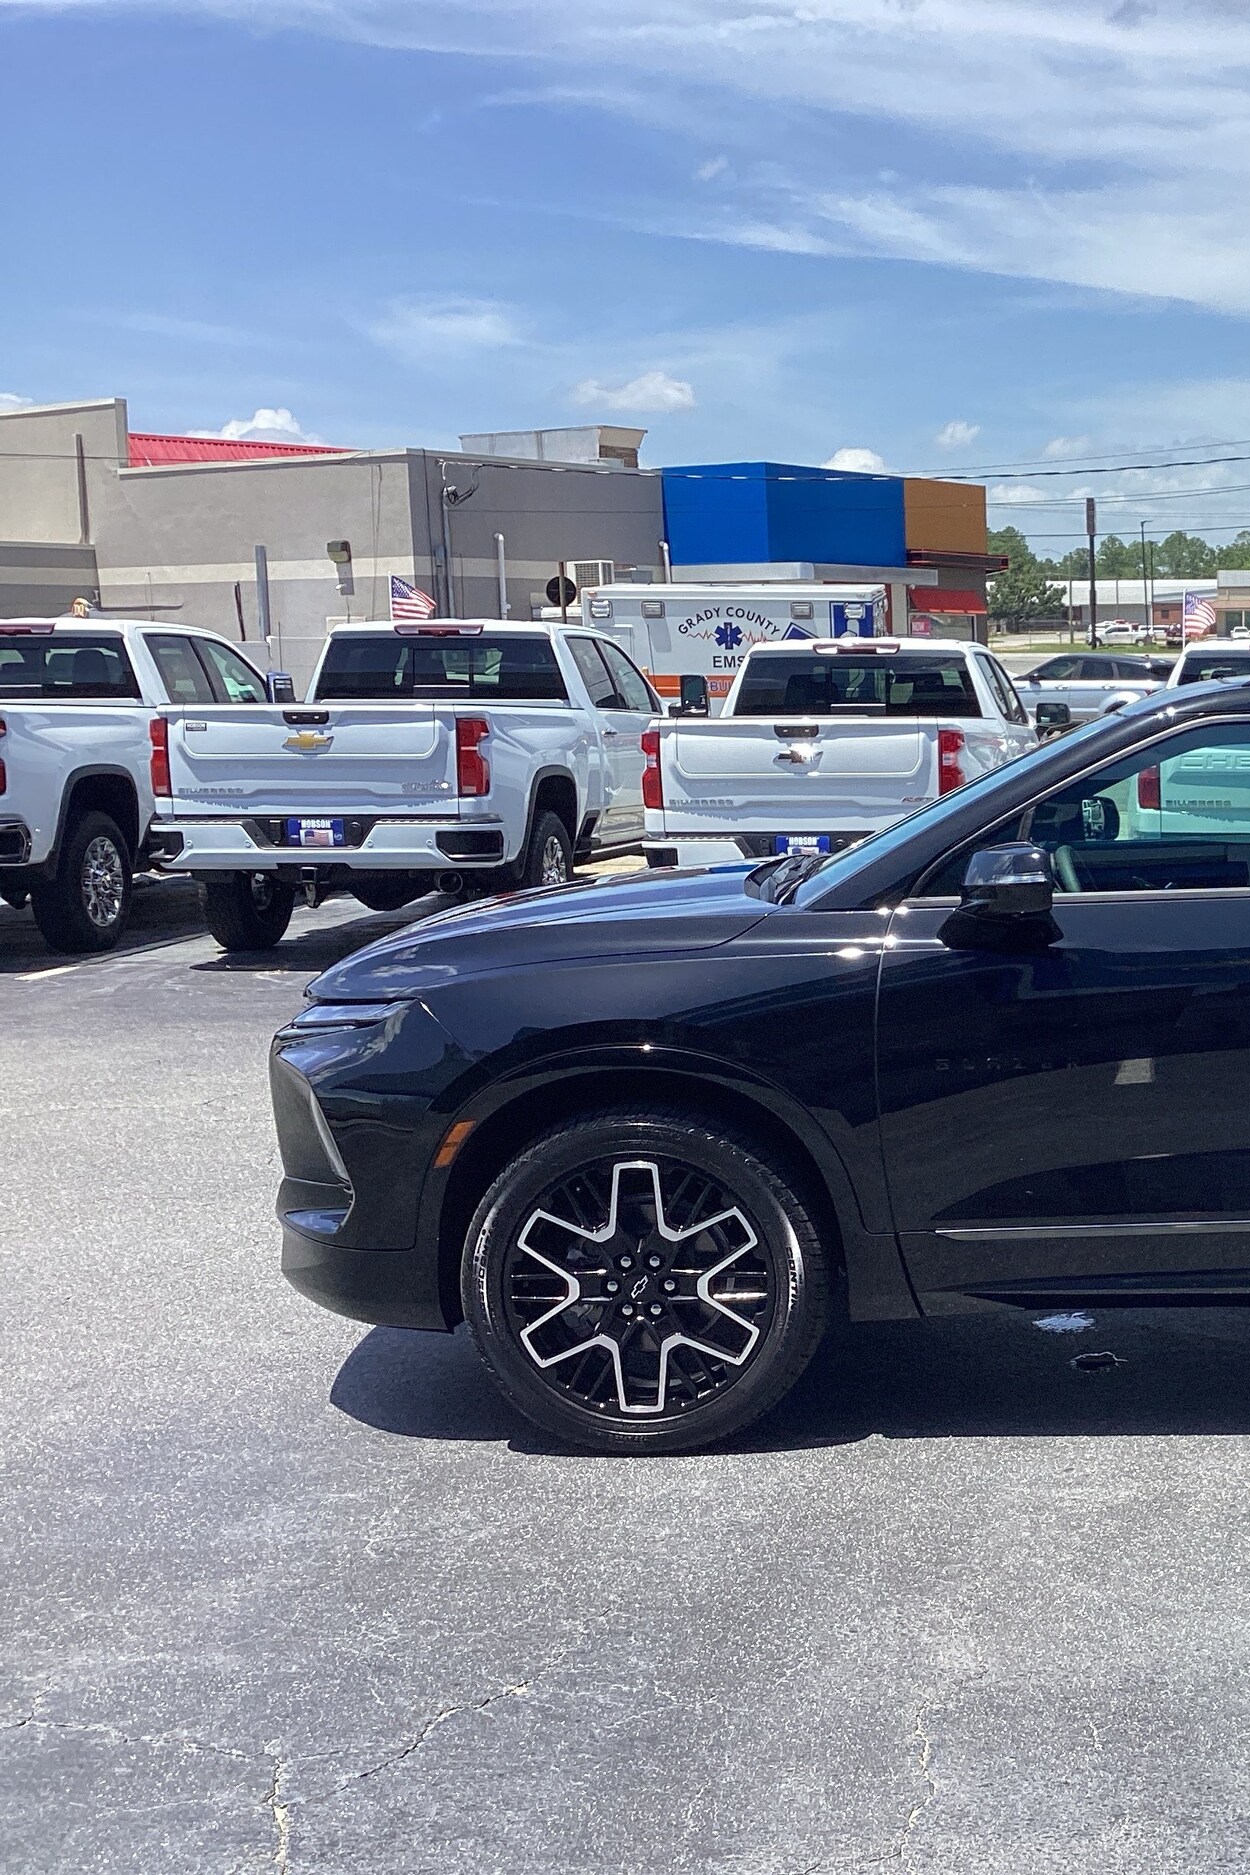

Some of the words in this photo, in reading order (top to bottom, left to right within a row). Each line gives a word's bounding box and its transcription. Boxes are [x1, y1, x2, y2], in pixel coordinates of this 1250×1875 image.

[678, 607, 721, 634] GRADY
[726, 606, 781, 636] COUNTY
[713, 655, 745, 668] EMS
